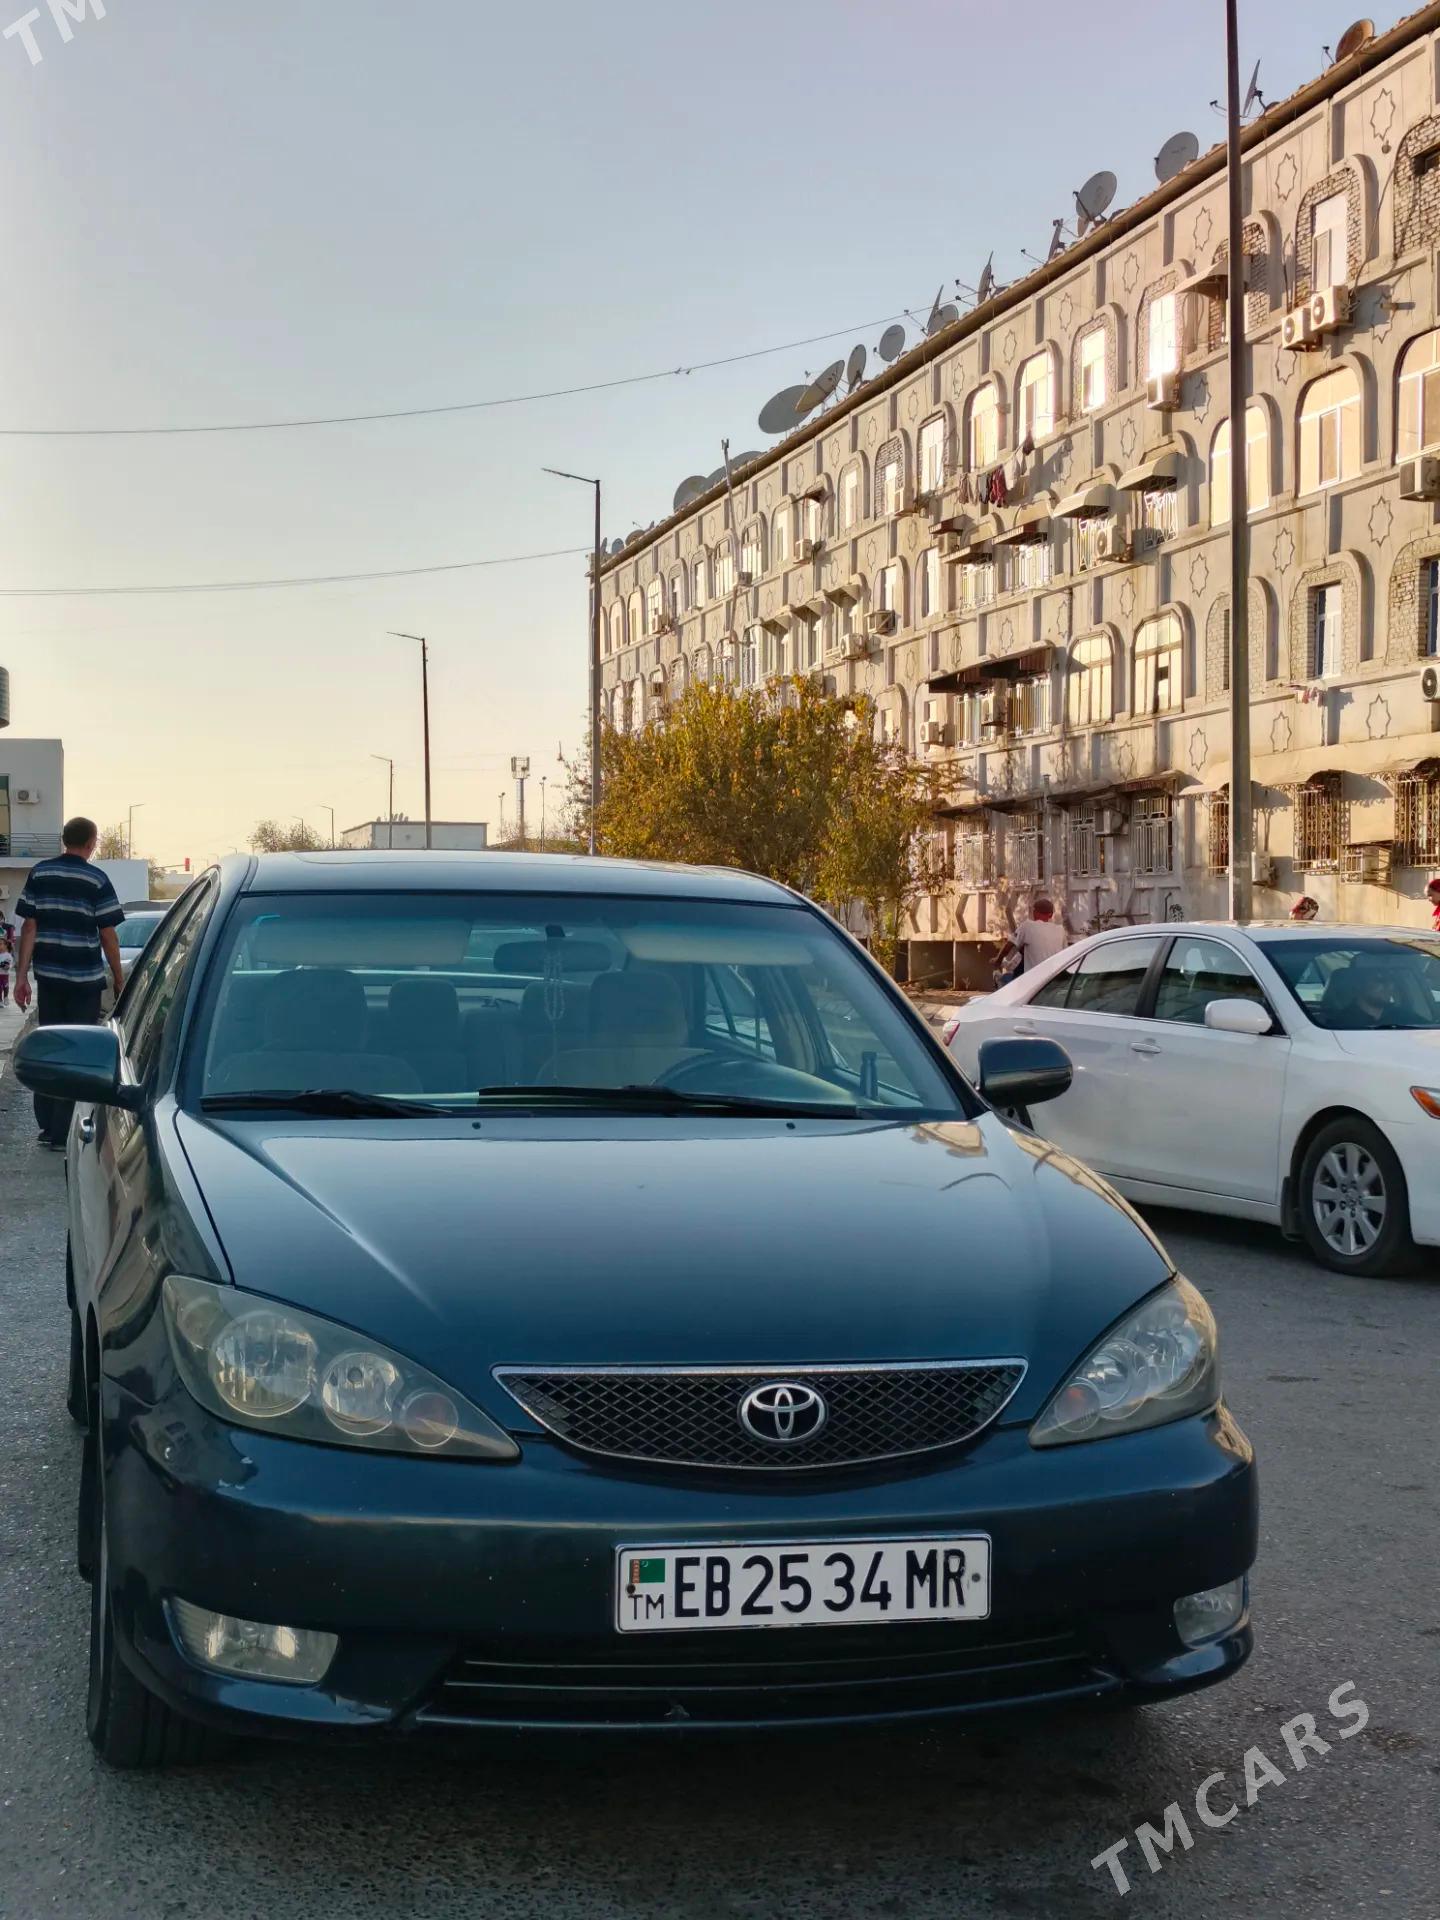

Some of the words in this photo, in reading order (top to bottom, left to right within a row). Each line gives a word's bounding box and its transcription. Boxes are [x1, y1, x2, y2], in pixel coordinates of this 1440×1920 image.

[628, 1593, 664, 1620] TM
[674, 1556, 731, 1617] EB
[740, 1551, 892, 1615] 2534
[905, 1549, 966, 1609] MR
